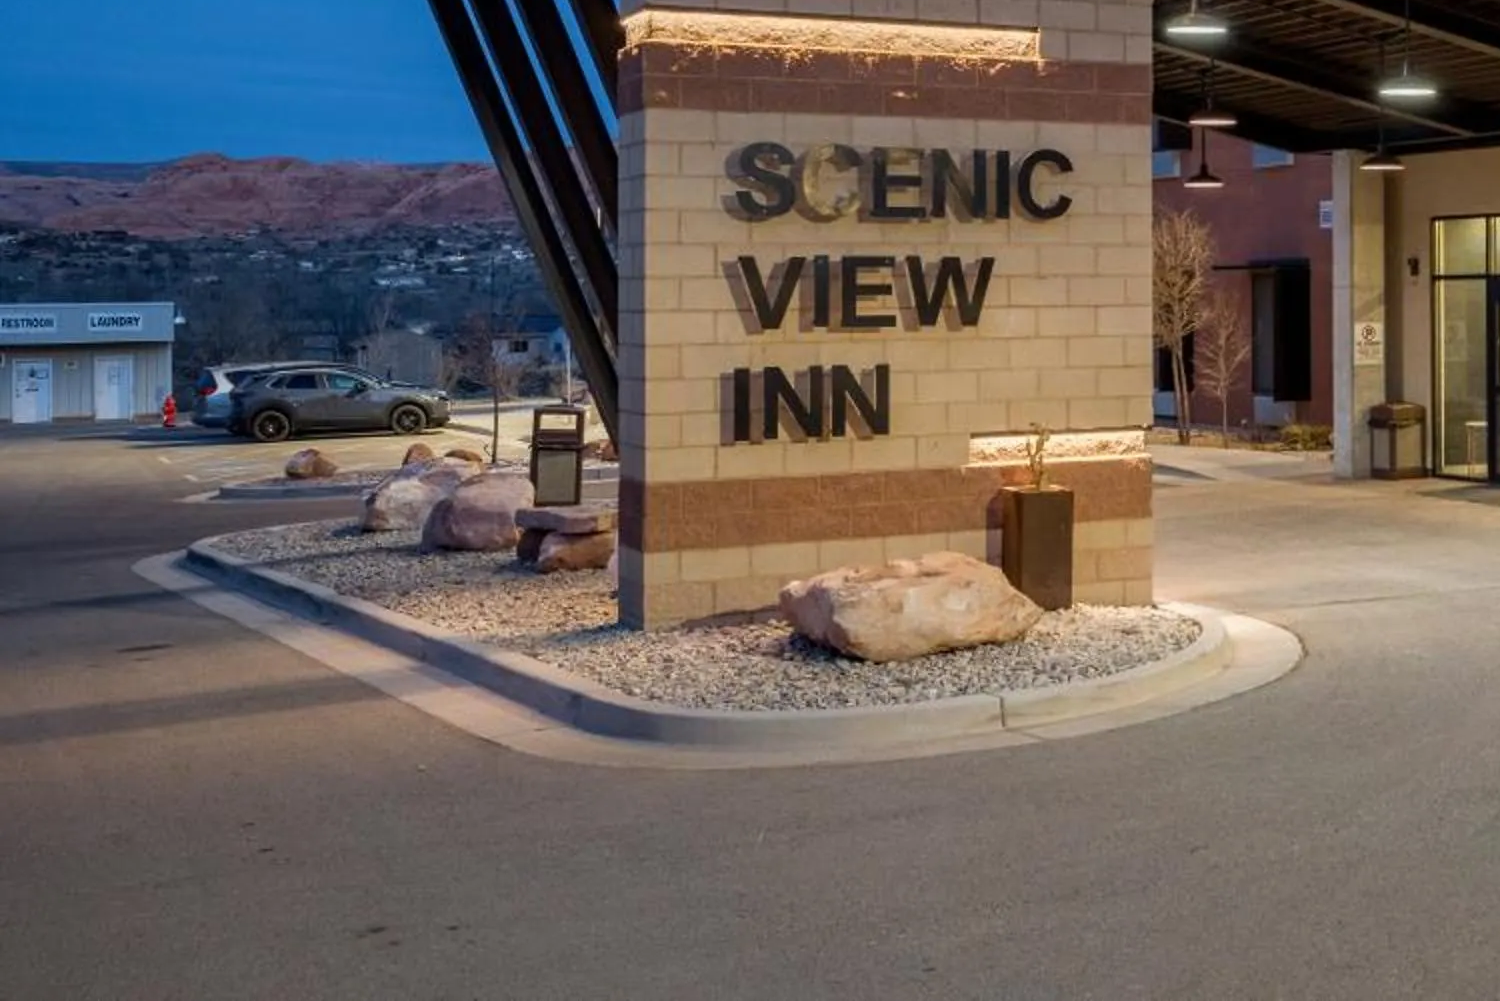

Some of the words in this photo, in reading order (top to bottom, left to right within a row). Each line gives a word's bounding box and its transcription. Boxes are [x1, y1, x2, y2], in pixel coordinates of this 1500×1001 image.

[734, 140, 1075, 222] SCENIC
[1, 317, 55, 328] RESTROOM
[90, 316, 141, 328] LAUNDRY
[738, 254, 996, 331] VIEW
[733, 363, 890, 442] INN
